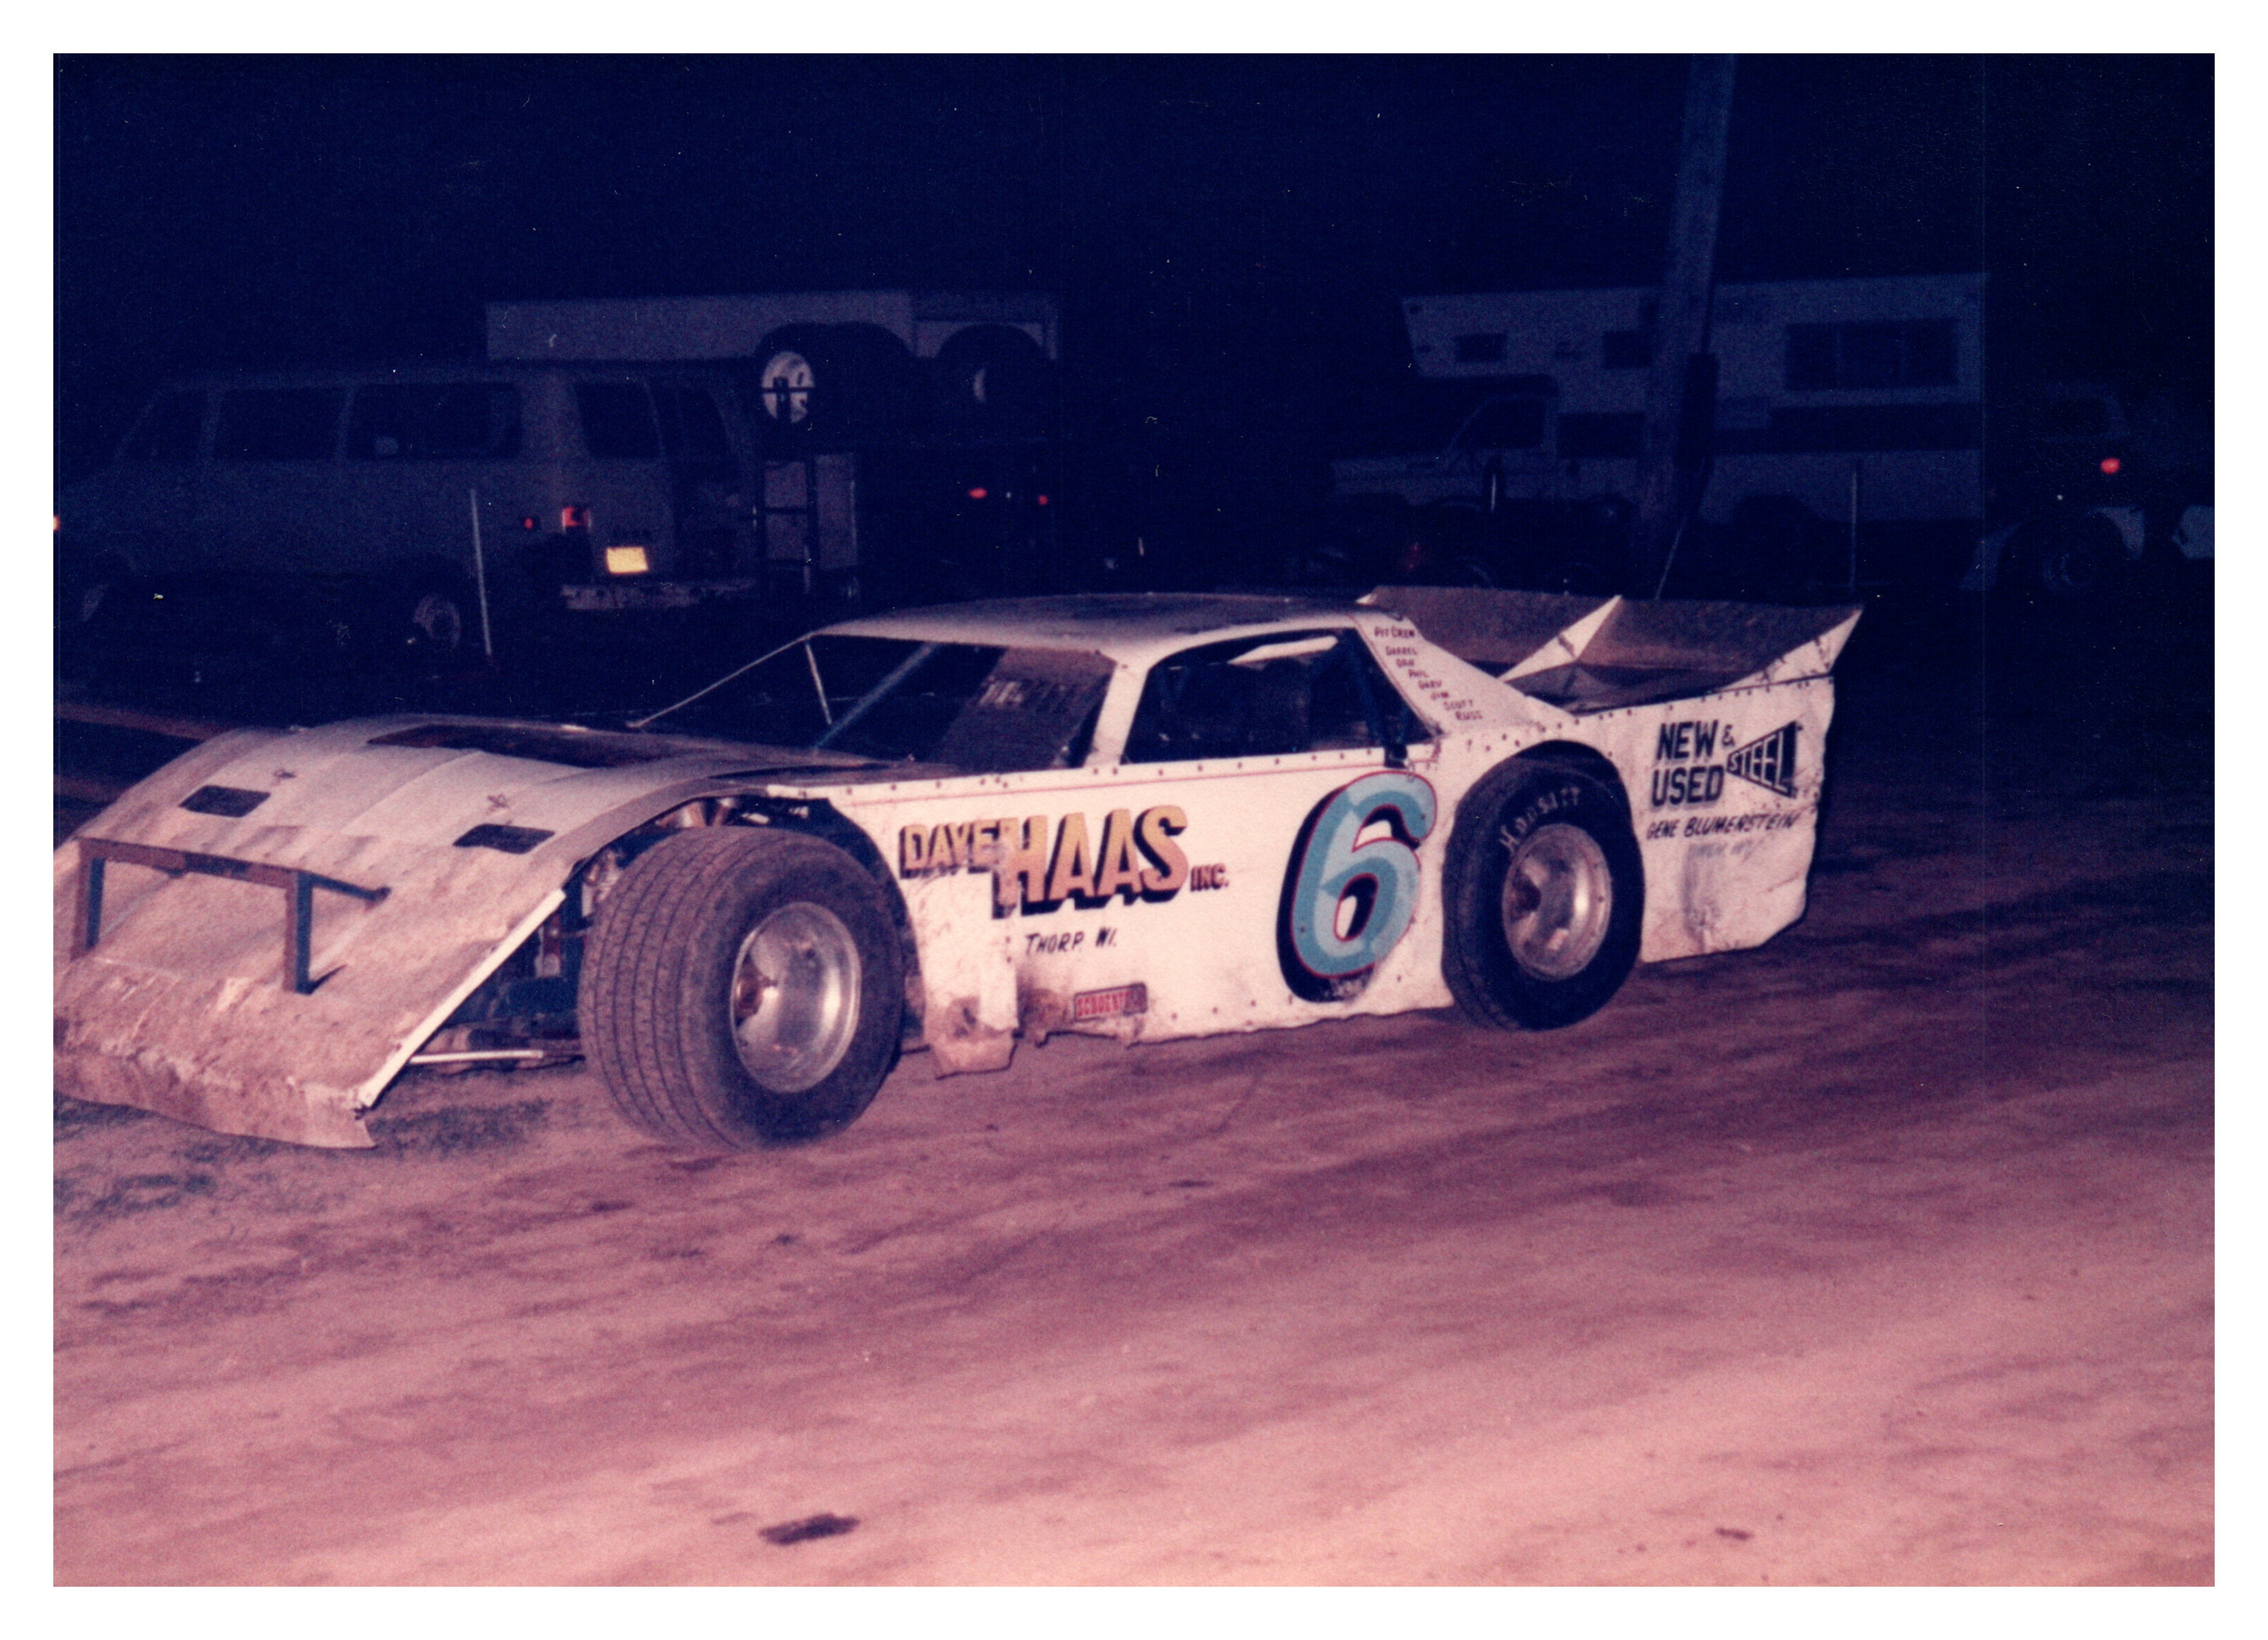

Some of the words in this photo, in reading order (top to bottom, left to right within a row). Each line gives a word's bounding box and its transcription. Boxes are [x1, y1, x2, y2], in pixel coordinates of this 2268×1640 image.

[1652, 764, 1724, 807] USED
[1728, 728, 1790, 794] STEEL
[1656, 719, 1718, 761] NEW
[1722, 724, 1735, 747] &
[899, 820, 1000, 879] DAVE
[992, 806, 1188, 920] HAAS
[1190, 863, 1229, 892] INC.
[1647, 819, 1679, 839] GENE
[1684, 812, 1801, 837] BLUMENSTEIN
[1276, 770, 1437, 1003] 6
